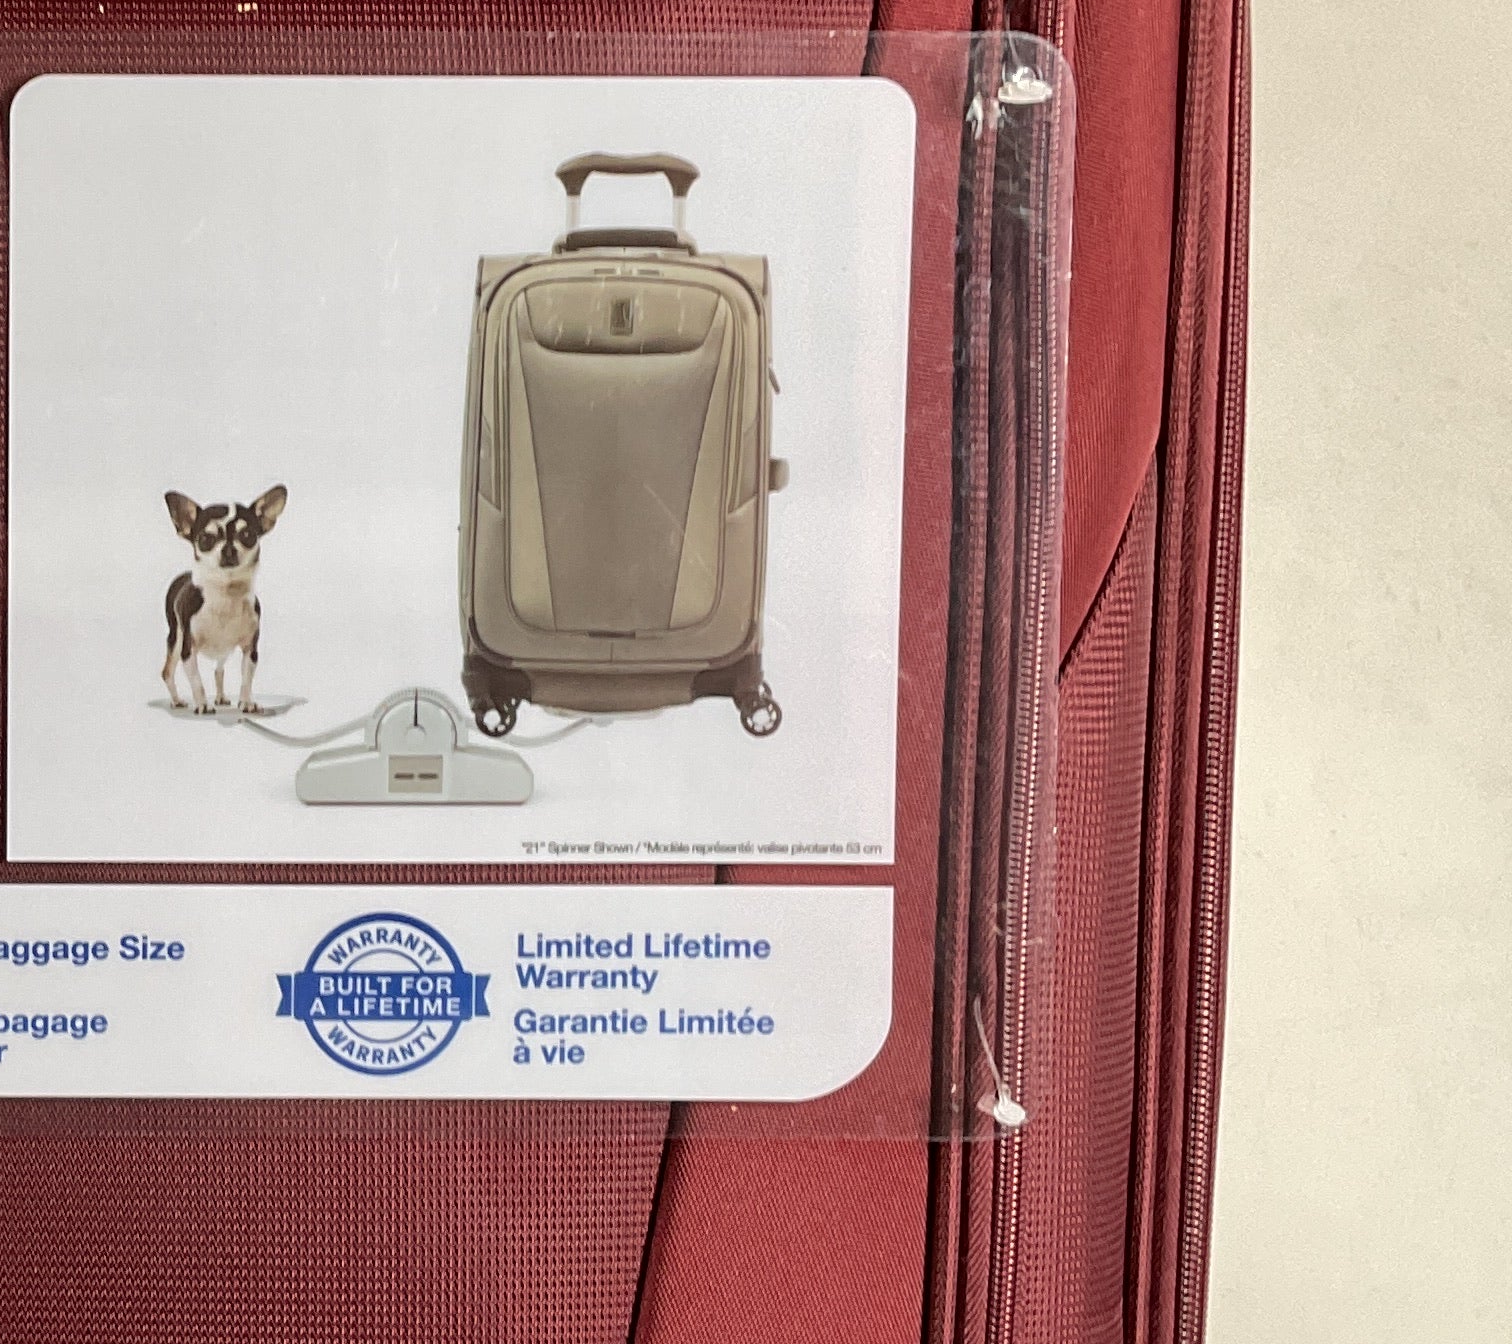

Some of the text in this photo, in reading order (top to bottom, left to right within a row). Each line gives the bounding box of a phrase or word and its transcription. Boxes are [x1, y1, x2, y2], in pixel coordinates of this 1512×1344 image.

[863, 845, 882, 854] cm
[120, 935, 184, 960] Size
[327, 926, 442, 967] WARRANTY
[518, 933, 770, 958] Limited Lifetime
[319, 976, 452, 996] BUILT FOR
[516, 964, 657, 994] Warranty
[309, 996, 460, 1018] A LIFETIME
[514, 1007, 774, 1034] Garantie Limitée
[326, 1024, 437, 1065] WARRANTY
[513, 1037, 584, 1064] à vie
